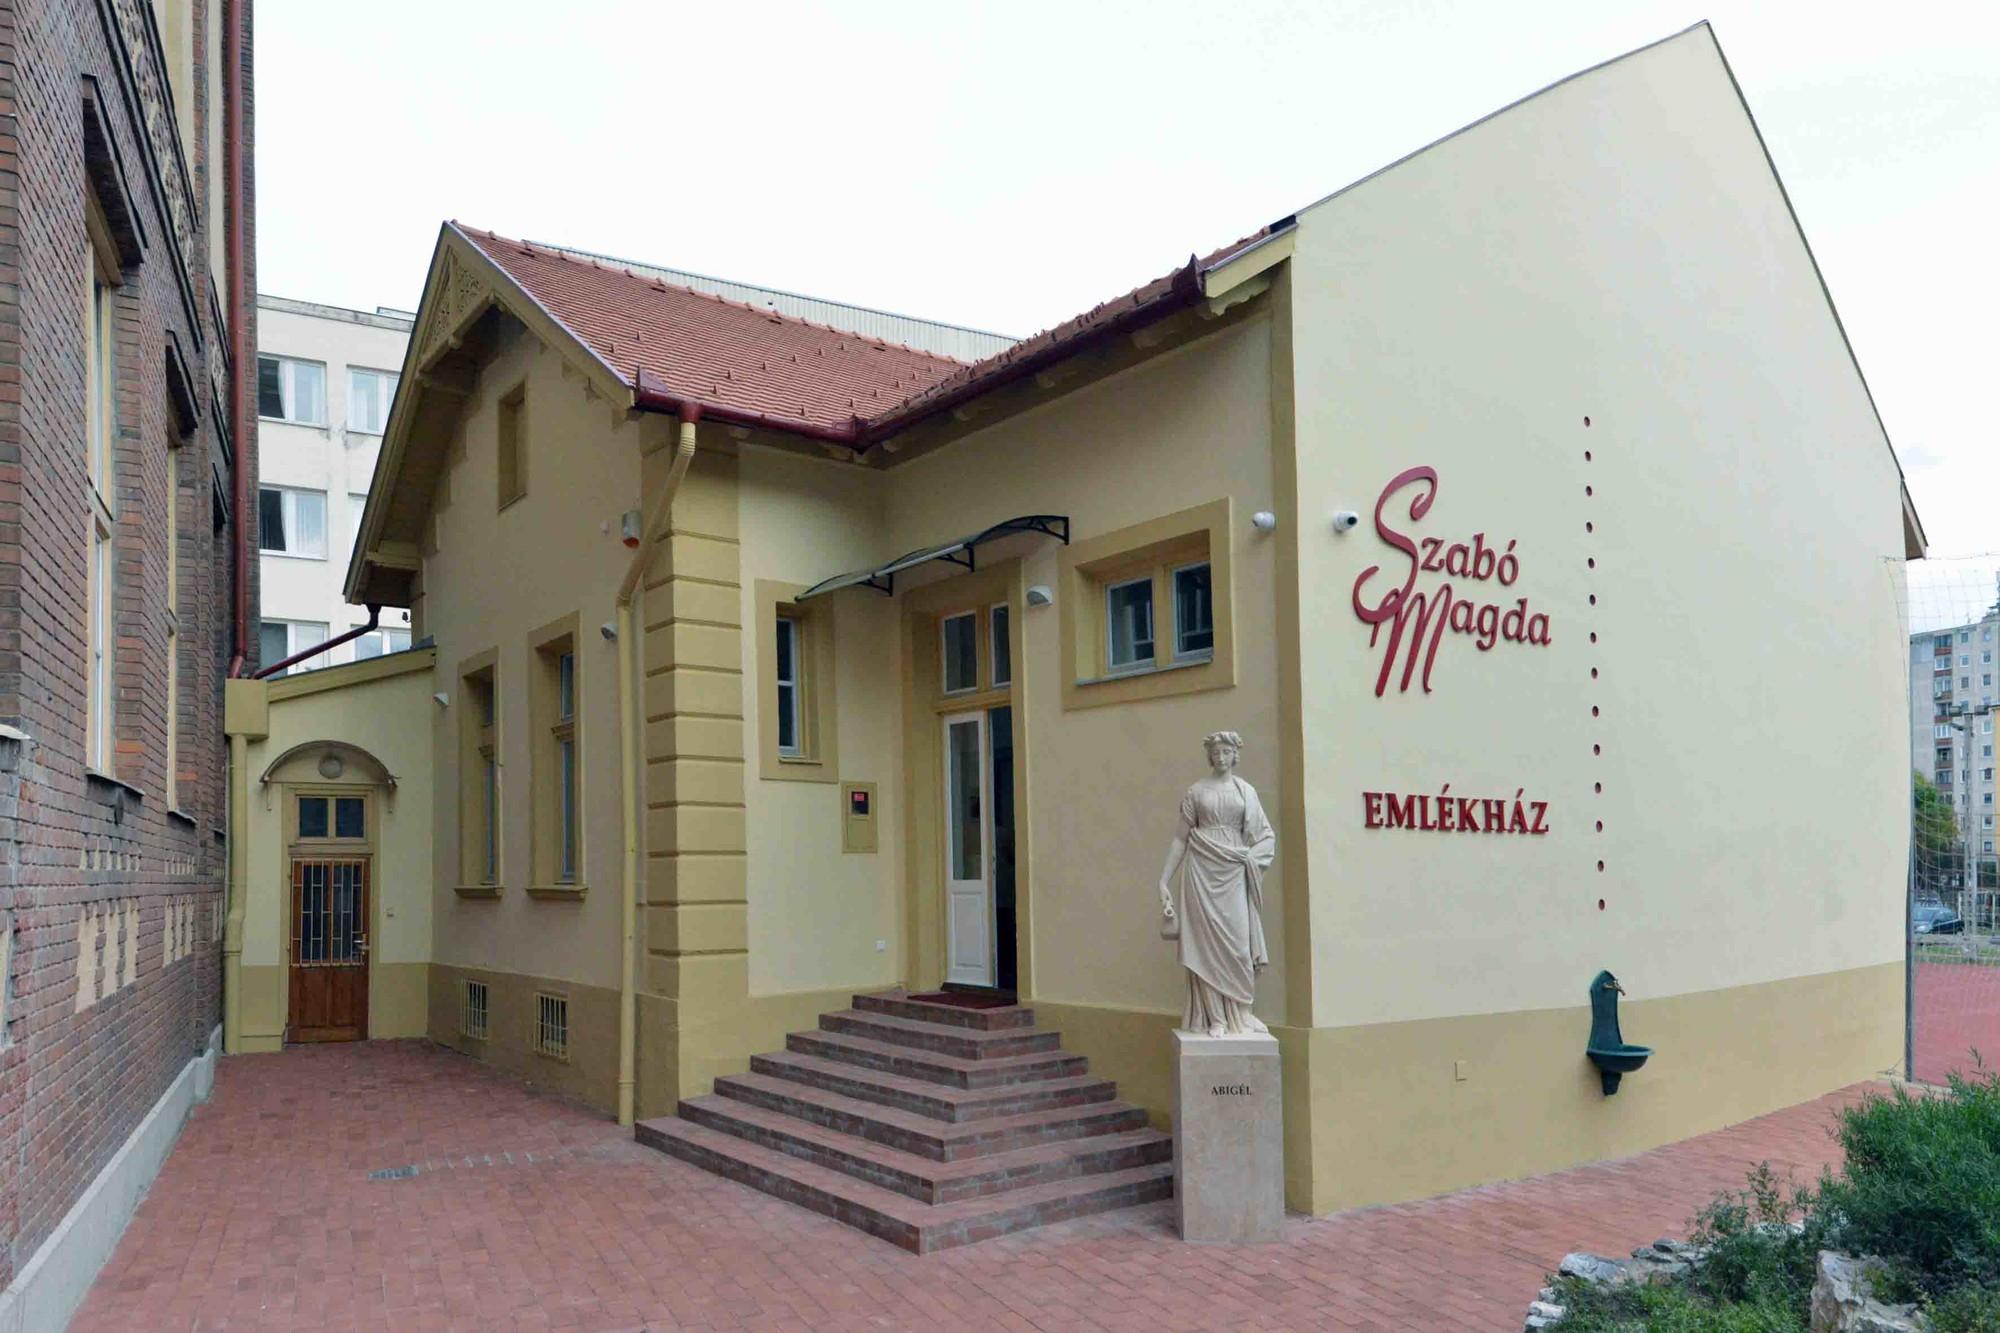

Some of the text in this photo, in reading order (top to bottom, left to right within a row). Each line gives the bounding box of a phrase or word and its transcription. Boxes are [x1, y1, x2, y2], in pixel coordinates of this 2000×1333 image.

[1353, 465, 1519, 624] Szabó
[1370, 583, 1552, 697] Magda
[1363, 783, 1550, 834] EMLÉKHÁZ
[1211, 1083, 1252, 1096] ABIGÉL
